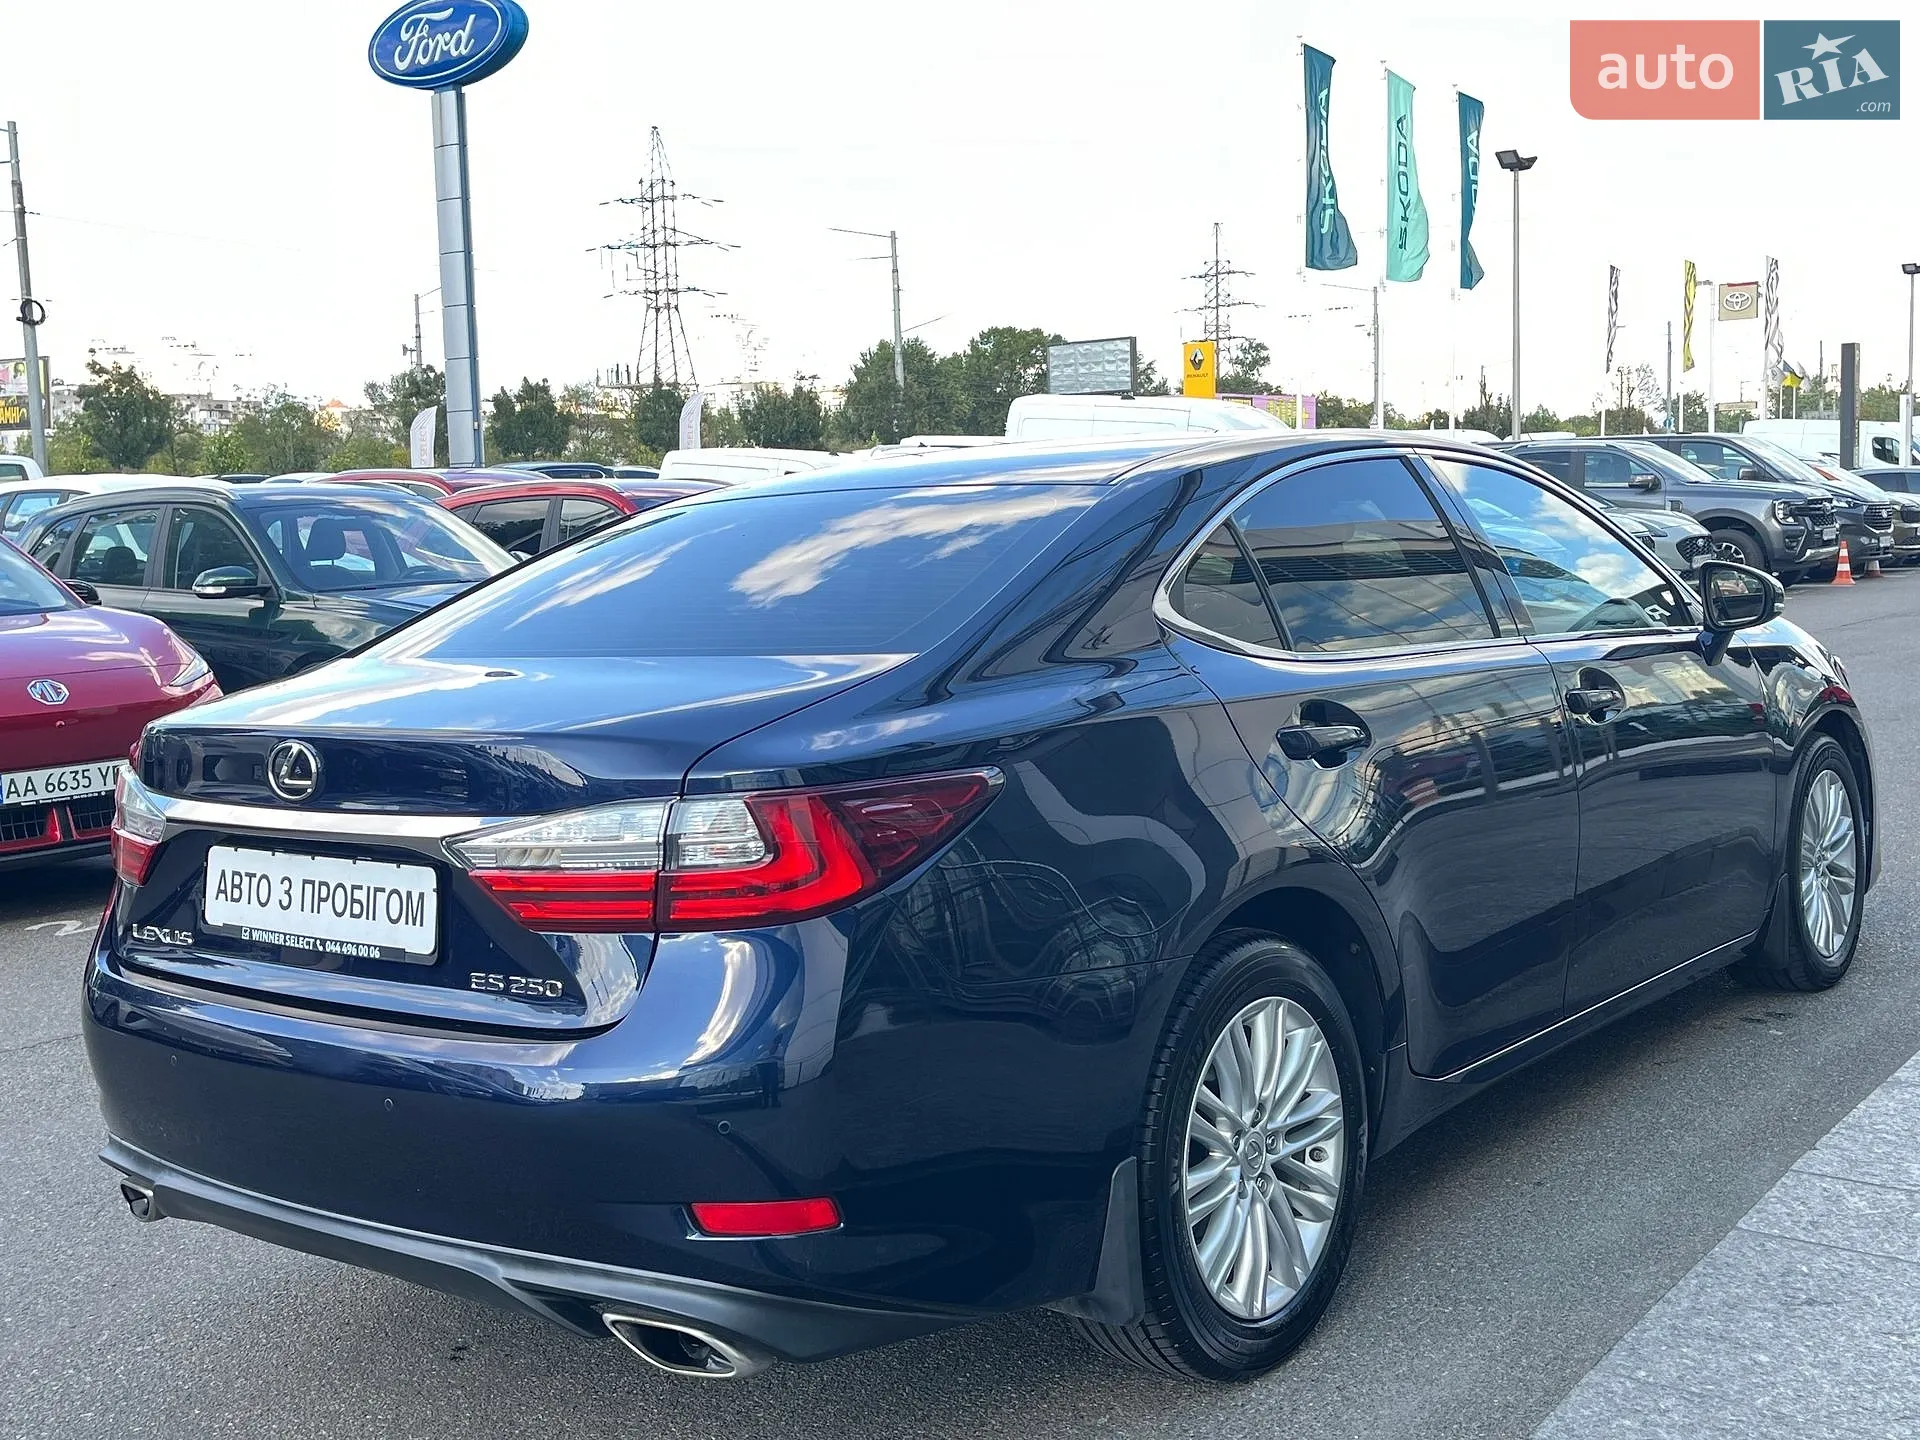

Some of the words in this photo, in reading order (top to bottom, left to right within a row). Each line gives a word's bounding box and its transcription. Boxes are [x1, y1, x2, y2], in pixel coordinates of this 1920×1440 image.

[394, 7, 477, 71] Ford
[1397, 114, 1411, 250] SKODA
[30, 681, 66, 702] MG
[6, 776, 38, 799] AA
[44, 769, 92, 793] 6635
[215, 869, 272, 908] АВТО
[278, 875, 292, 911] З
[300, 878, 425, 927] ПРОБІГОМ
[132, 923, 194, 946] LEXUS
[251, 928, 285, 945] WINNER
[285, 933, 315, 950] SELECT
[325, 940, 341, 953] 044
[342, 942, 357, 955] 496
[357, 943, 369, 956] 00
[369, 945, 381, 958] 06
[469, 972, 505, 991] ES
[508, 976, 563, 997] 250
